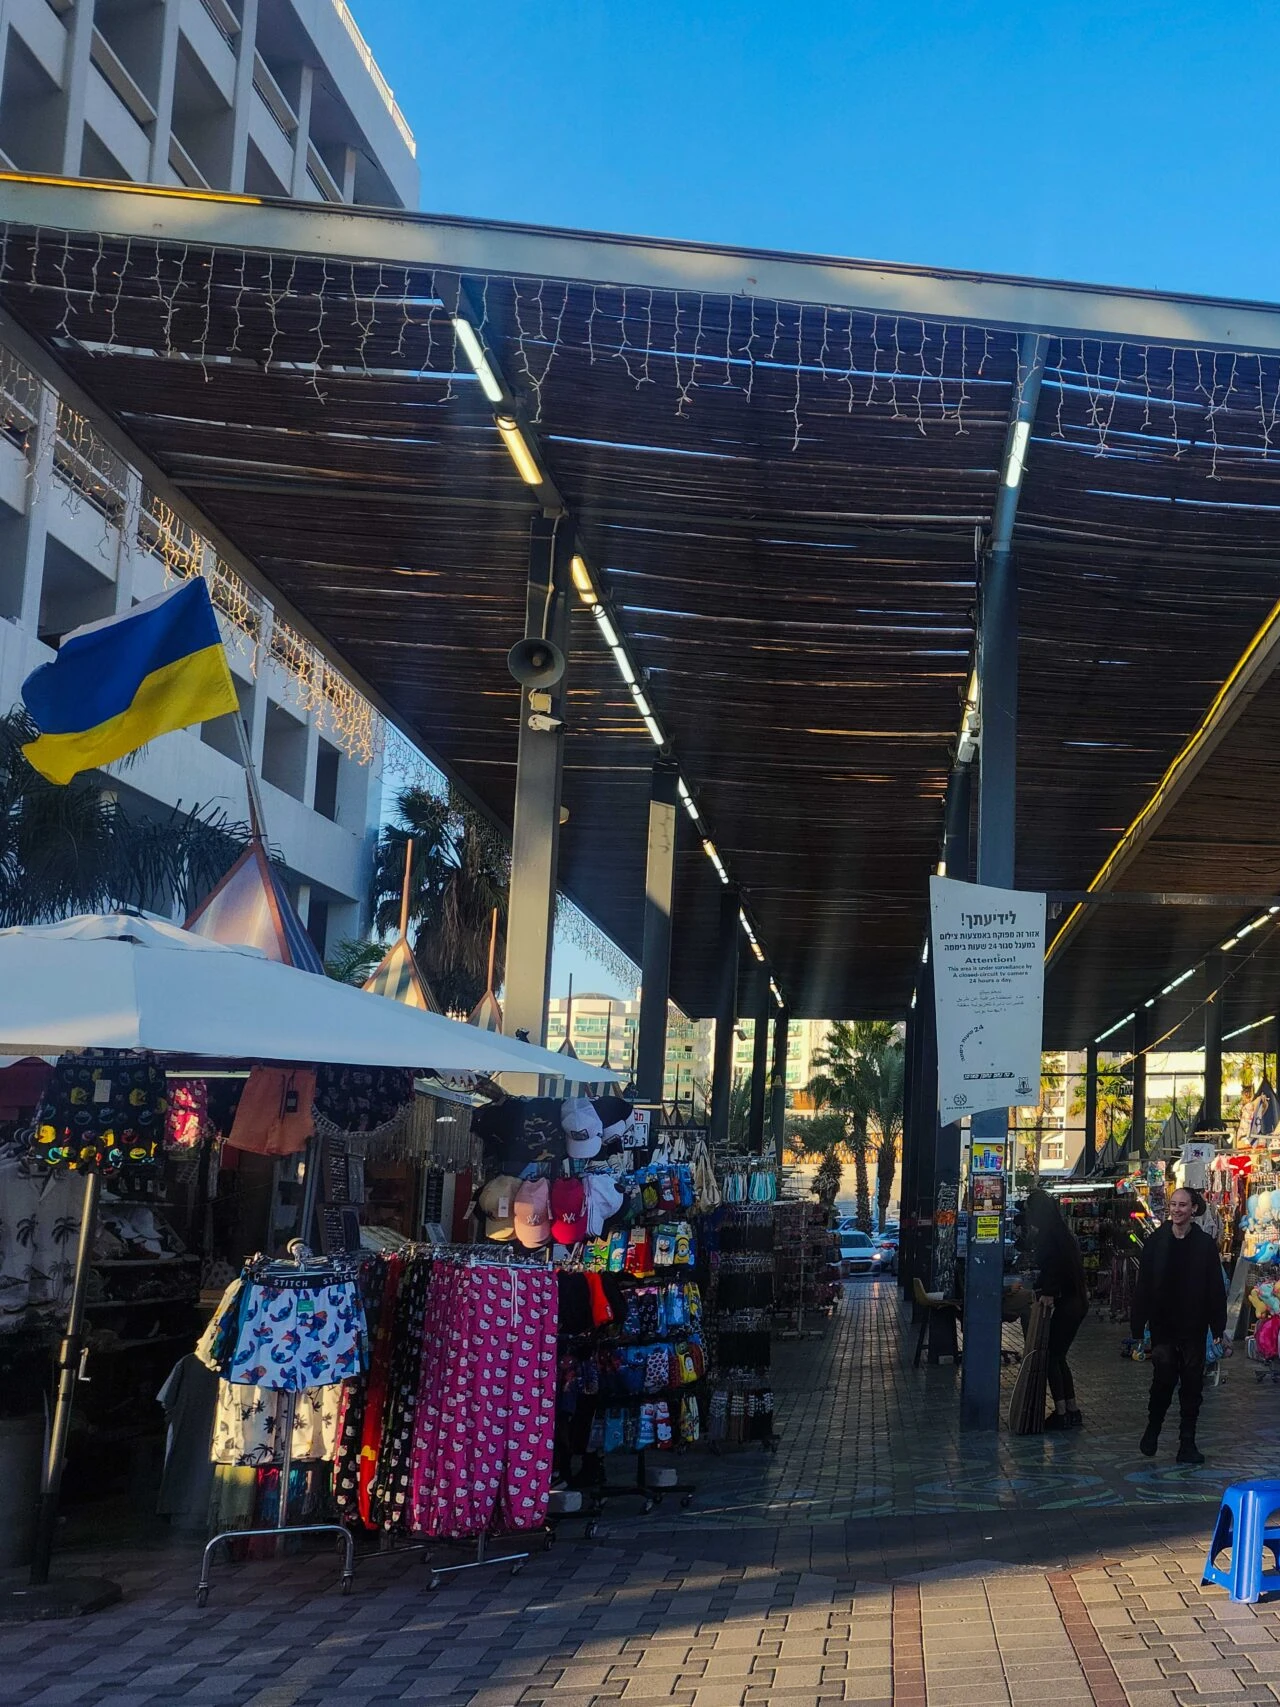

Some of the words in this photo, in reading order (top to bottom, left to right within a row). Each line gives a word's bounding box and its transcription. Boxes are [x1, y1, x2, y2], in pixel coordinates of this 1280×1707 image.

[961, 910, 1017, 930] לידיעתך!
[939, 932, 958, 941] צילום
[960, 932, 991, 941] באמצעות
[992, 931, 1015, 940] מפוקח
[1025, 930, 1040, 938] אזור
[967, 943, 987, 951] שעות
[999, 942, 1013, 950] סגור
[1014, 941, 1036, 949] במעגל
[964, 956, 1017, 964] Attention!
[973, 1024, 984, 1033] 24
[273, 1278, 309, 1288] STITCH
